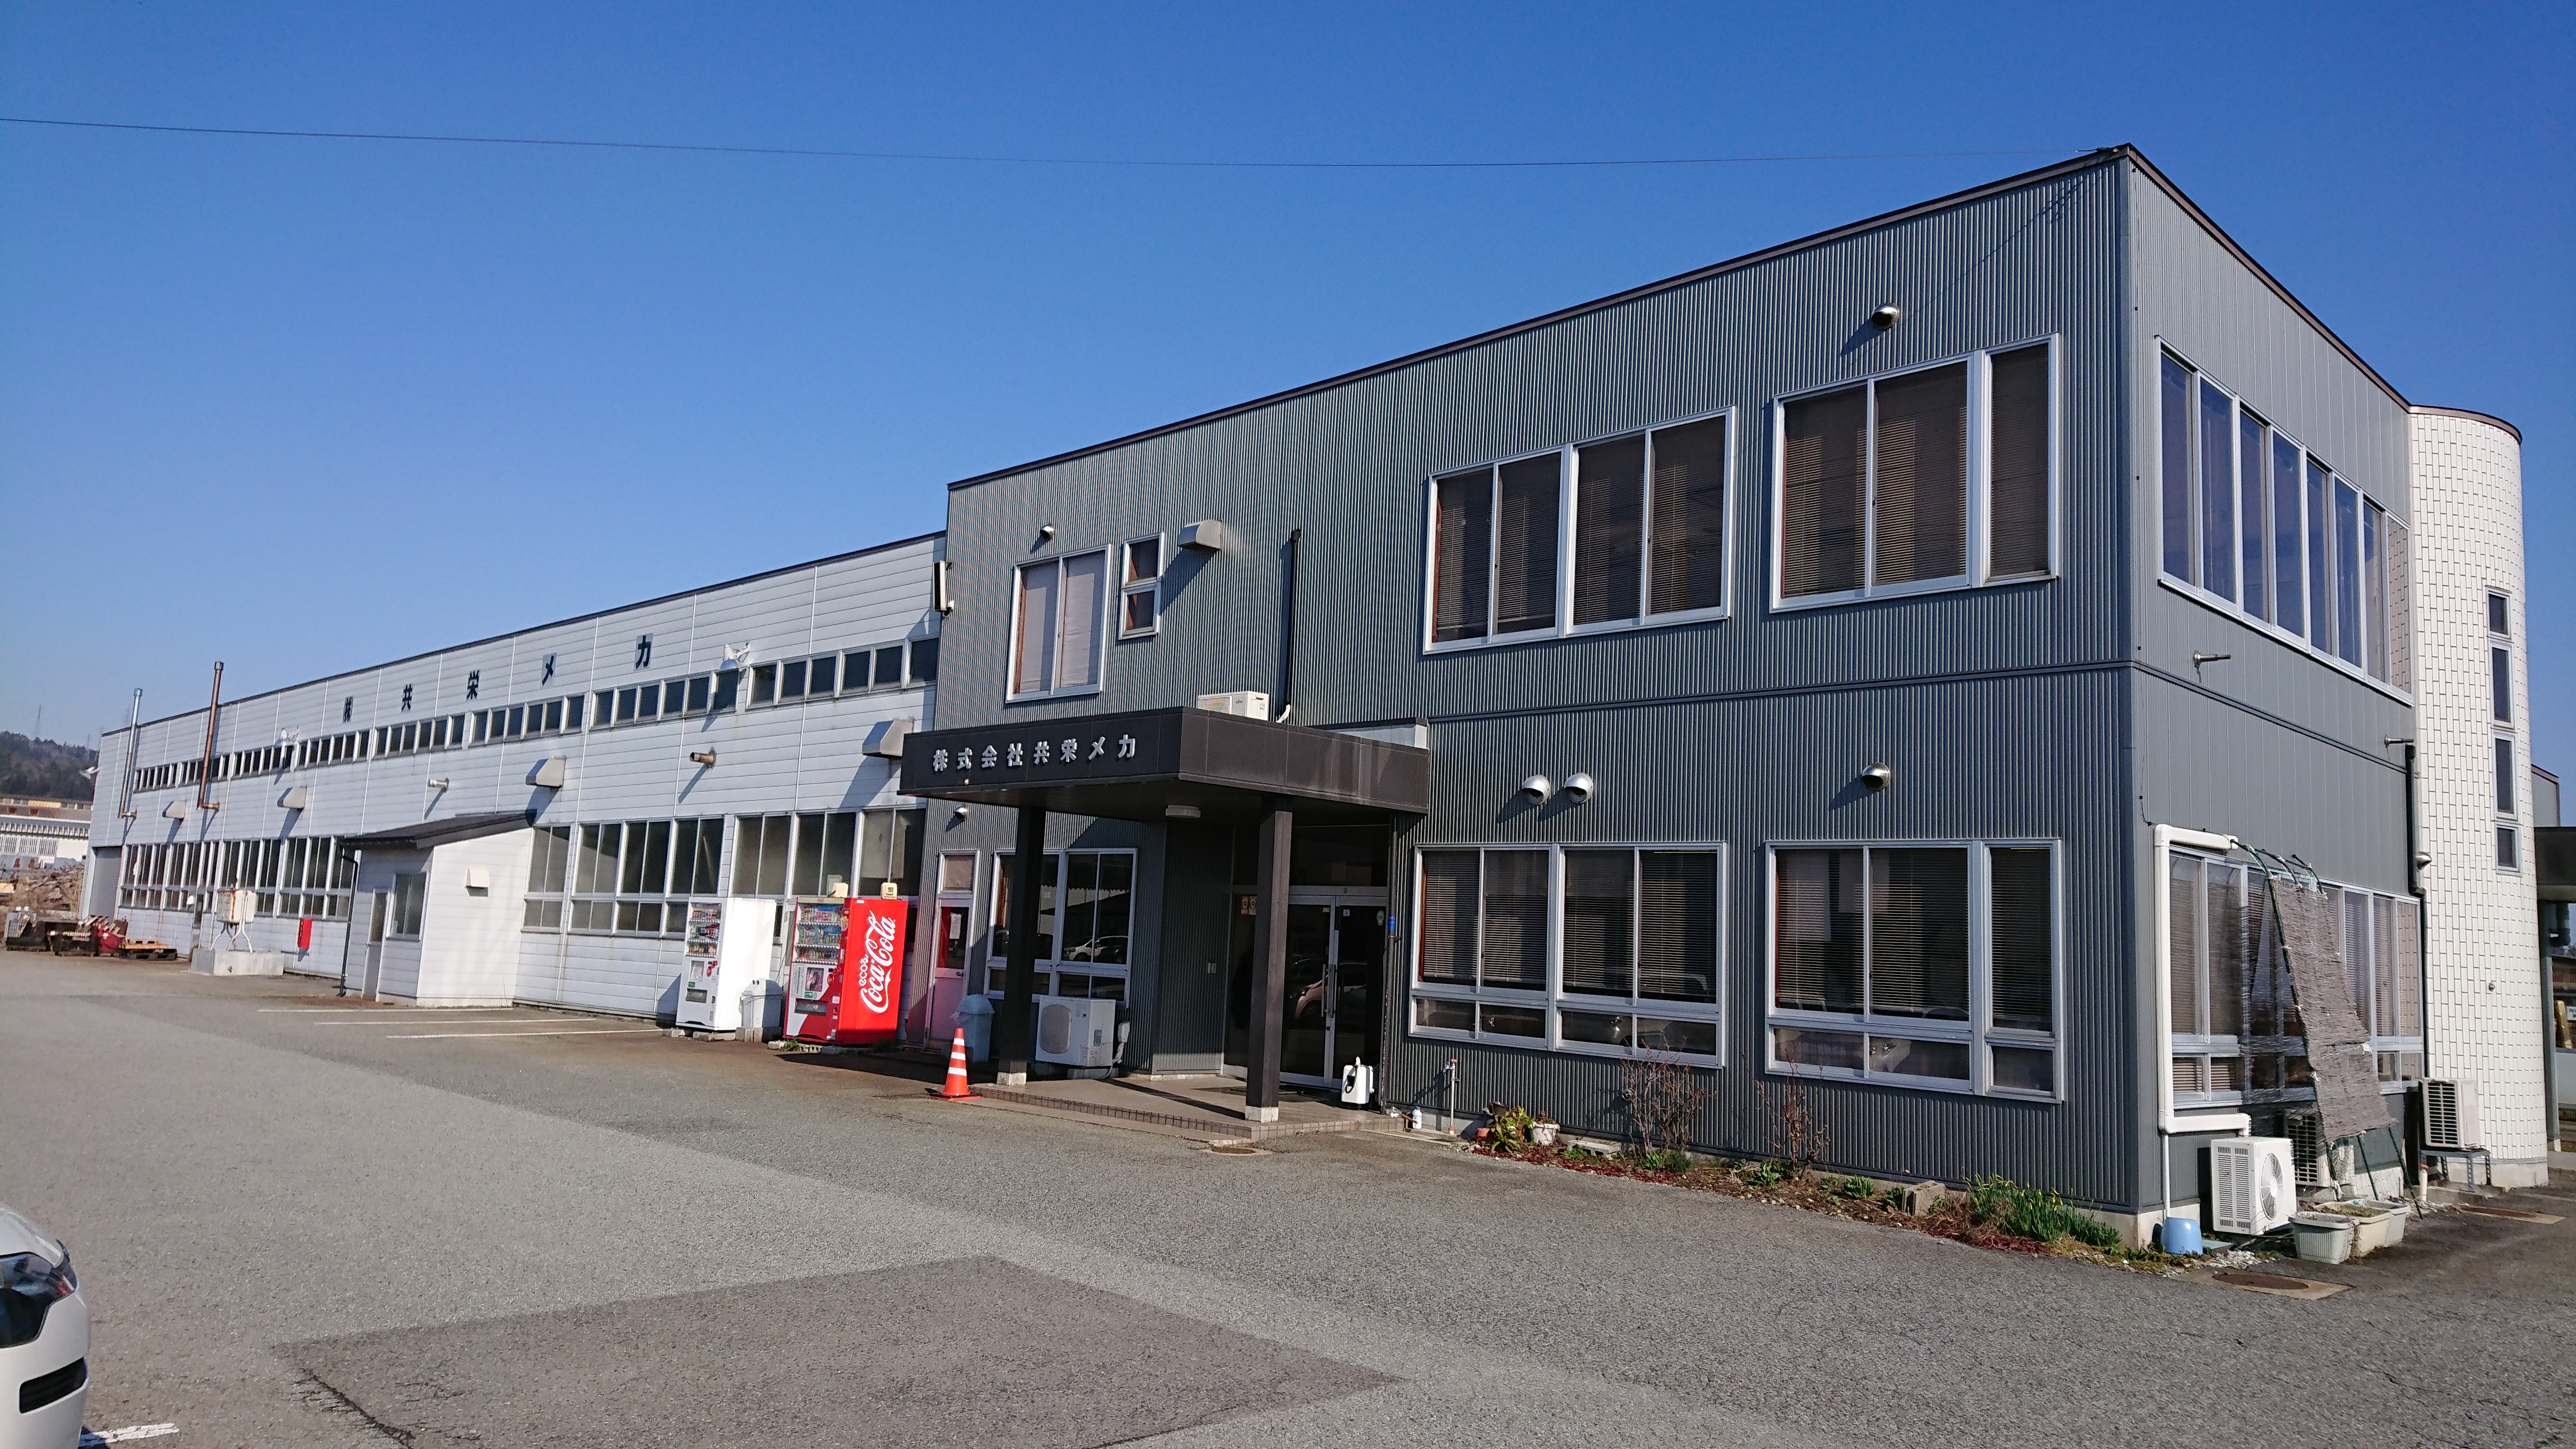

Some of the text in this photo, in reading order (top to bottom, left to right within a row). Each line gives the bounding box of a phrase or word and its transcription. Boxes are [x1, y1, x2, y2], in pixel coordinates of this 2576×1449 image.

[933, 734, 1136, 772] 株式会社共栄メカ
[860, 909, 896, 1013] Coca-Cola
